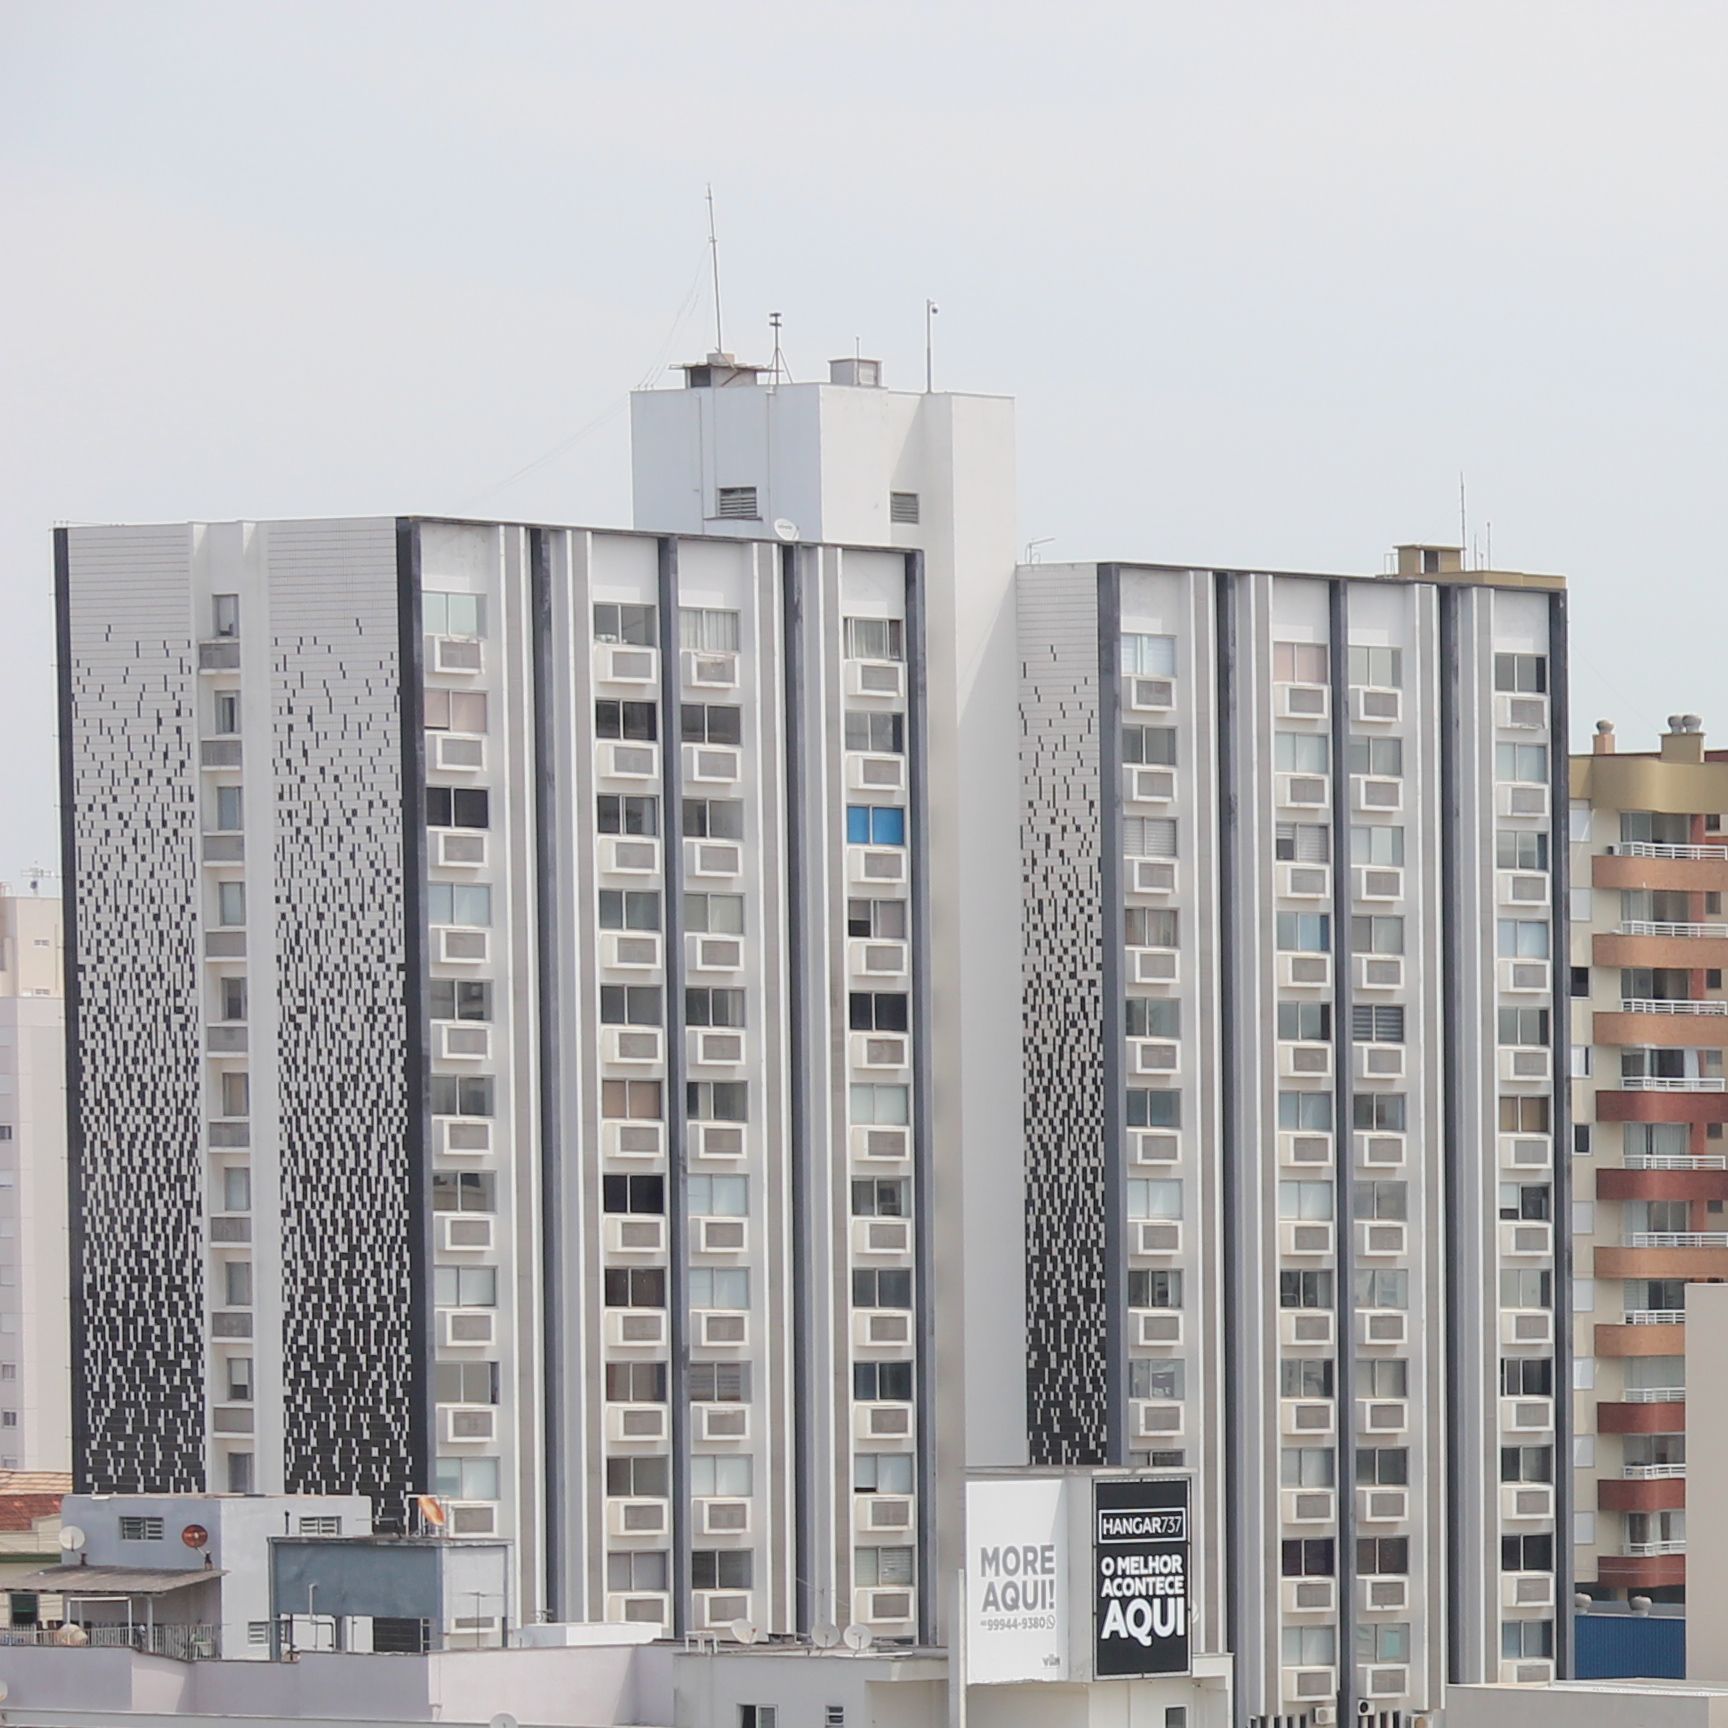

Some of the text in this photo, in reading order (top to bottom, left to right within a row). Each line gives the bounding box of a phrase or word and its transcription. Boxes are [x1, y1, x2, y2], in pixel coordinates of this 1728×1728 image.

[1102, 1515, 1182, 1535] HANGAR737
[980, 1544, 1055, 1577] MORE
[1101, 1554, 1183, 1576] O MELHOR
[981, 1579, 1055, 1612] AQUI!
[1101, 1575, 1185, 1598] ACONTECE
[1101, 1597, 1185, 1646] AQUI
